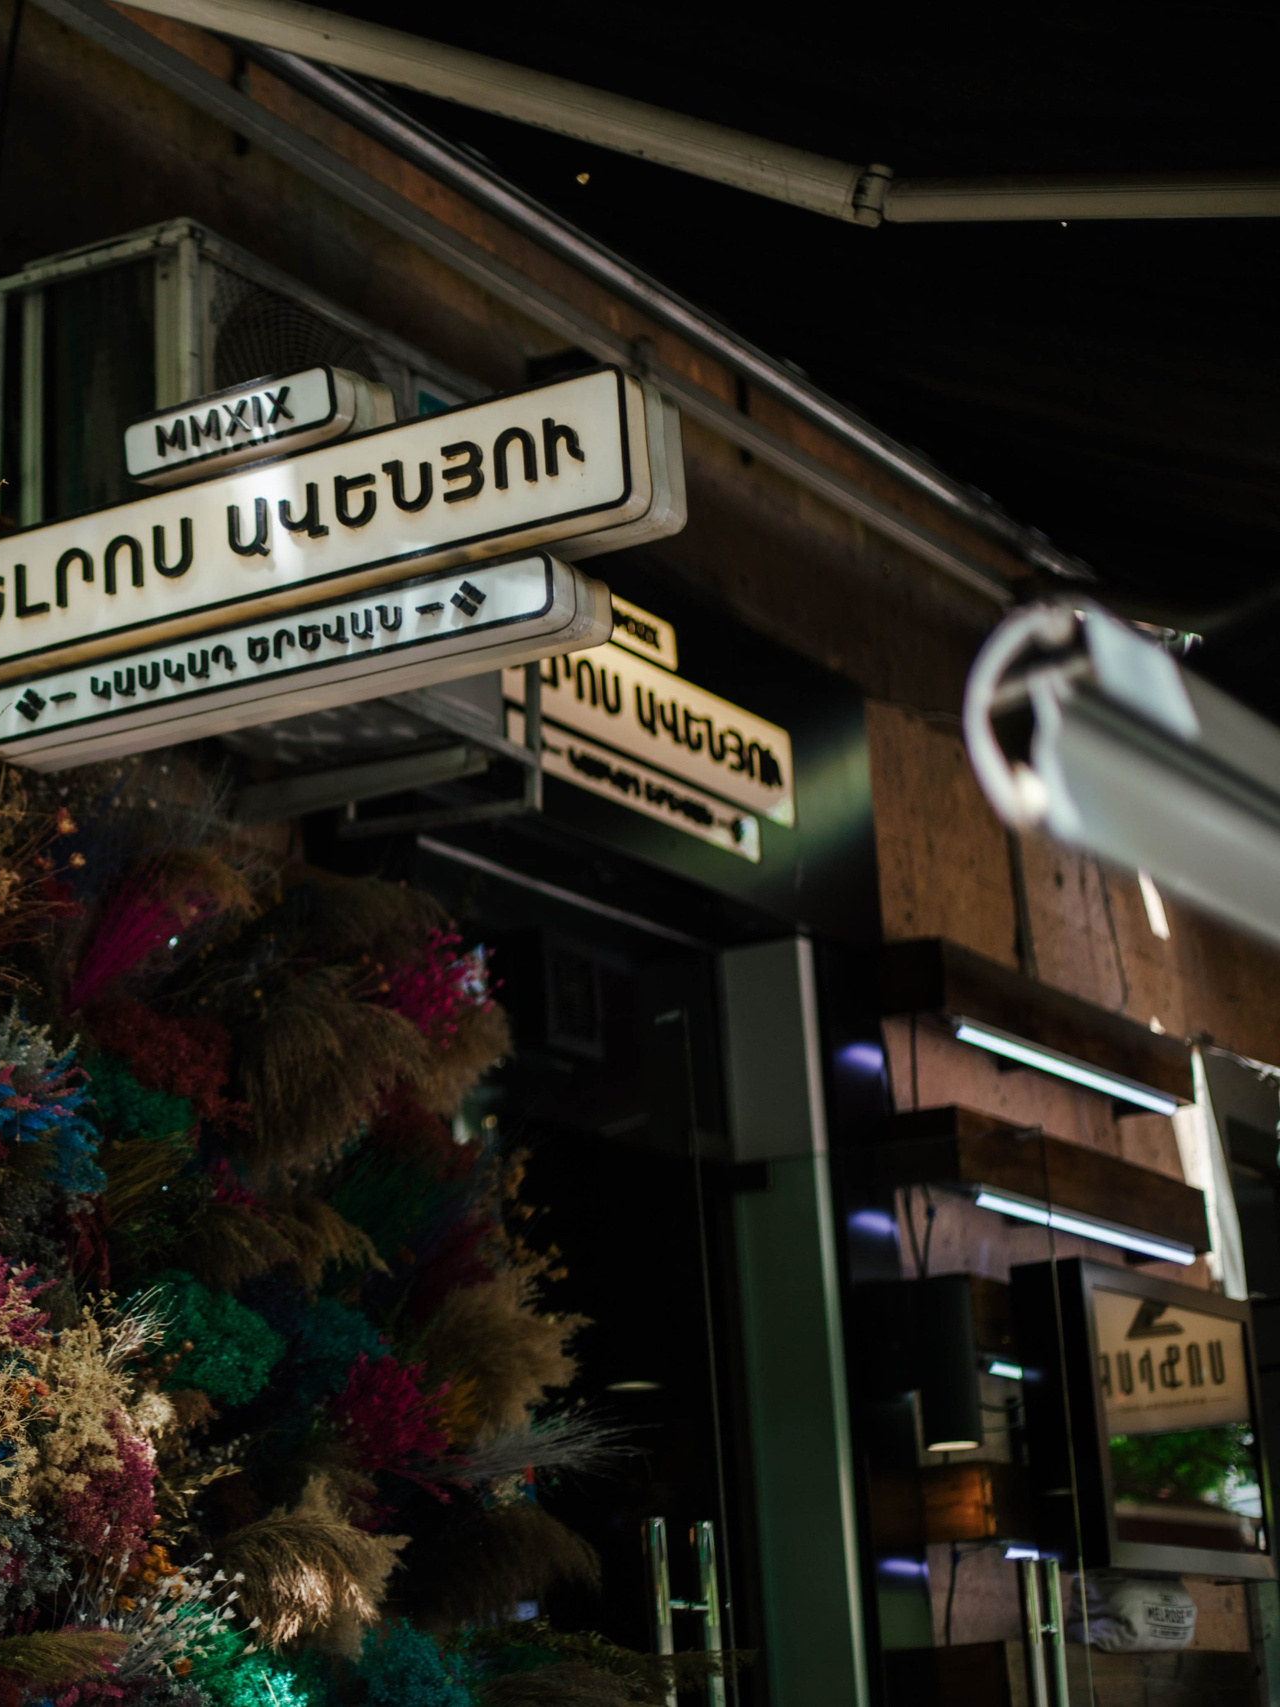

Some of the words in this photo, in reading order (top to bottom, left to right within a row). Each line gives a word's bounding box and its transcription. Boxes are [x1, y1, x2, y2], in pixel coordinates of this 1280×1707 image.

[155, 386, 294, 457] MMXIX
[227, 417, 585, 557] ԱՎԵՆՅՈՒ
[247, 604, 402, 664] ԵՐԵՎԱՆ
